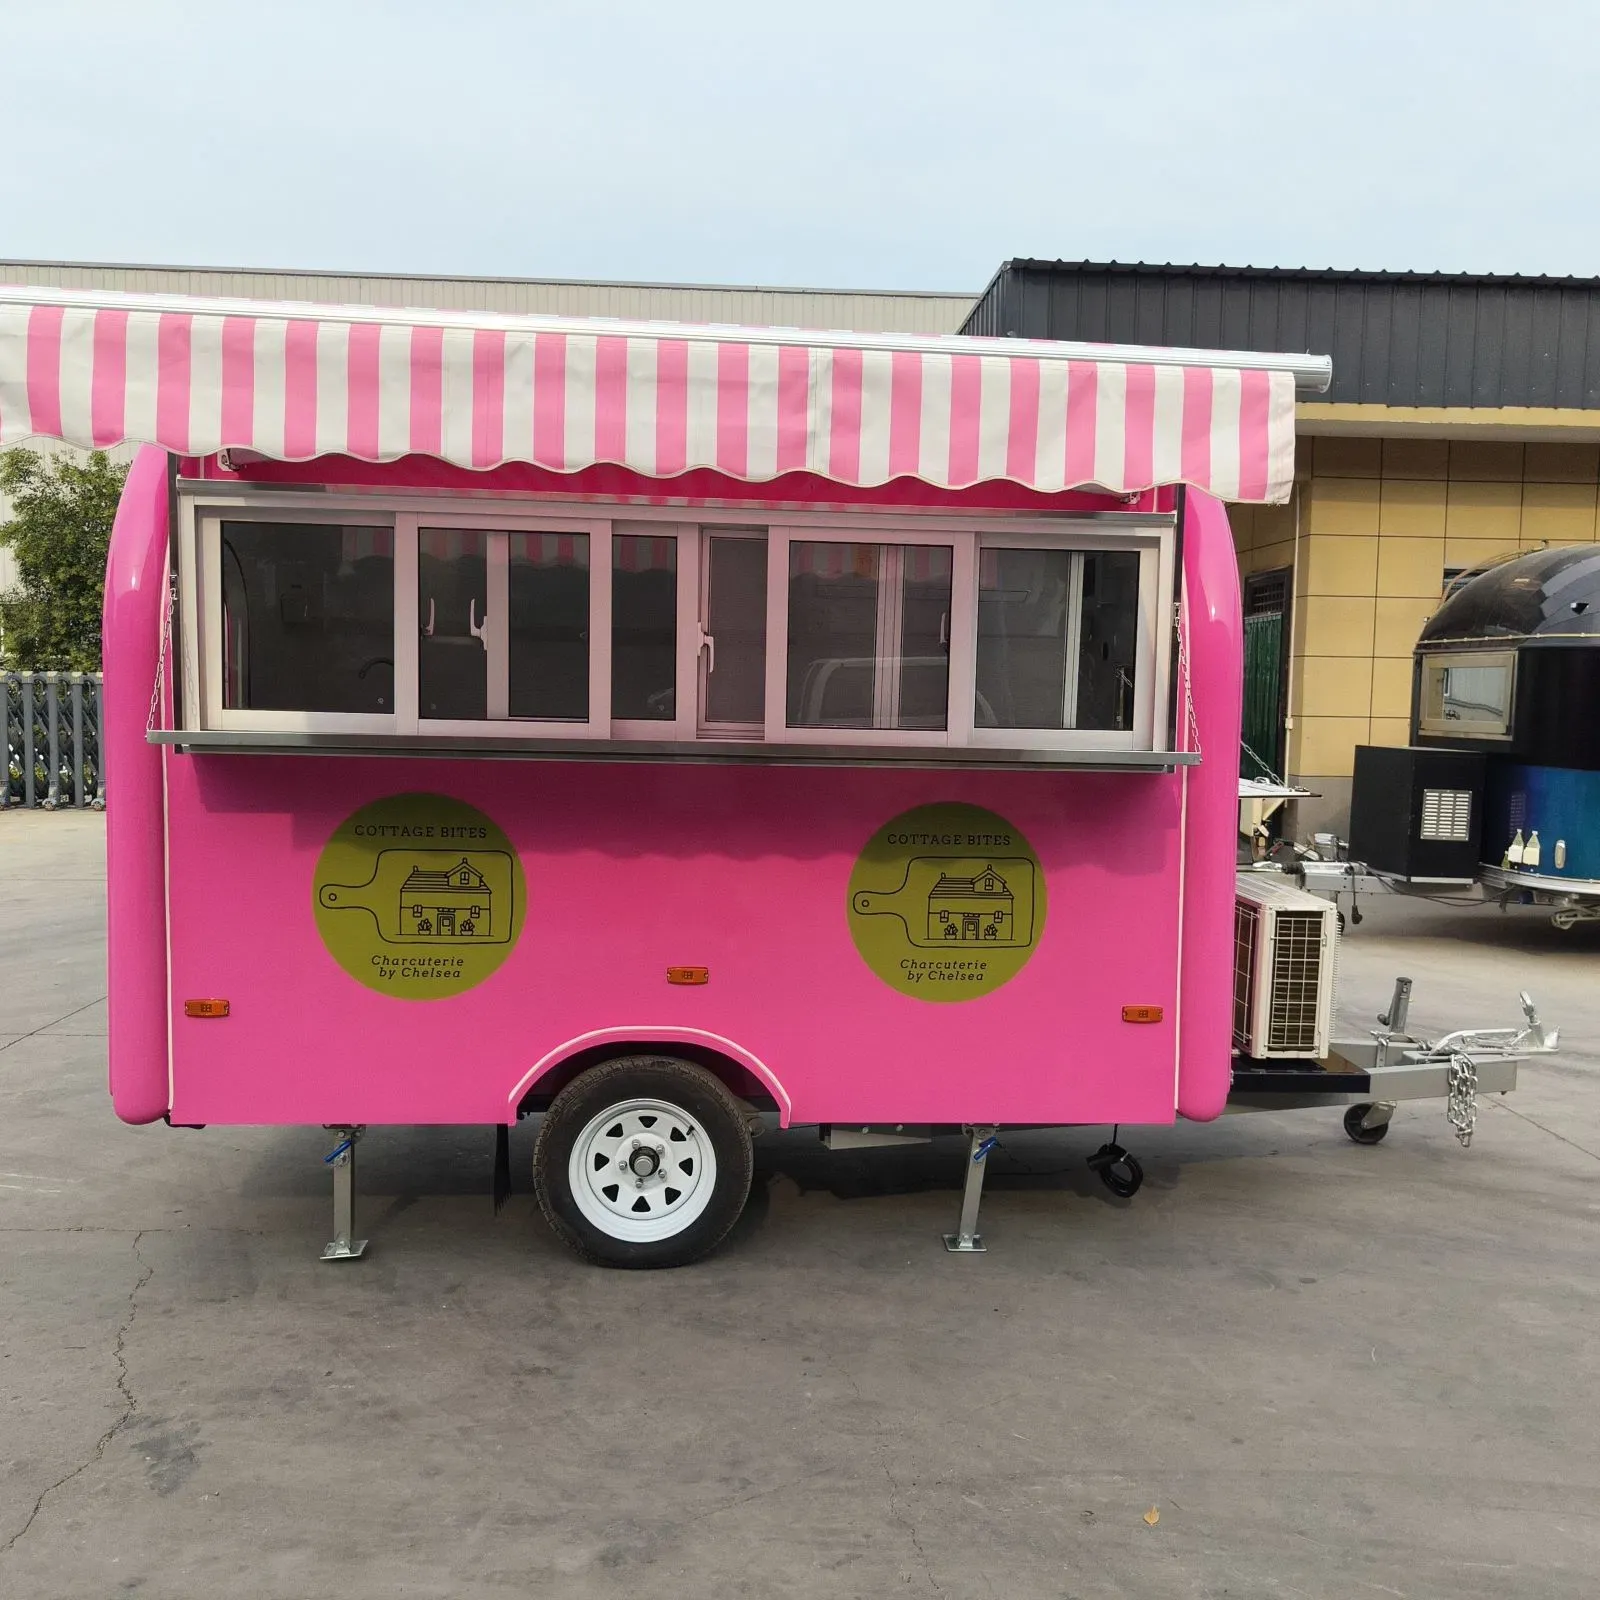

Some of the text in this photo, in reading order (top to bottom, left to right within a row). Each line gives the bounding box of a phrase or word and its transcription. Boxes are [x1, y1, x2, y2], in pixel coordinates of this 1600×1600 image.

[354, 824, 488, 839] COTTAGE BITES
[887, 834, 1012, 846] COTTAGE BITES
[371, 955, 465, 967] Charcuterie
[900, 959, 987, 970] Charcuterie
[379, 967, 461, 980] by Chelsea
[907, 971, 984, 983] by Chelsea
